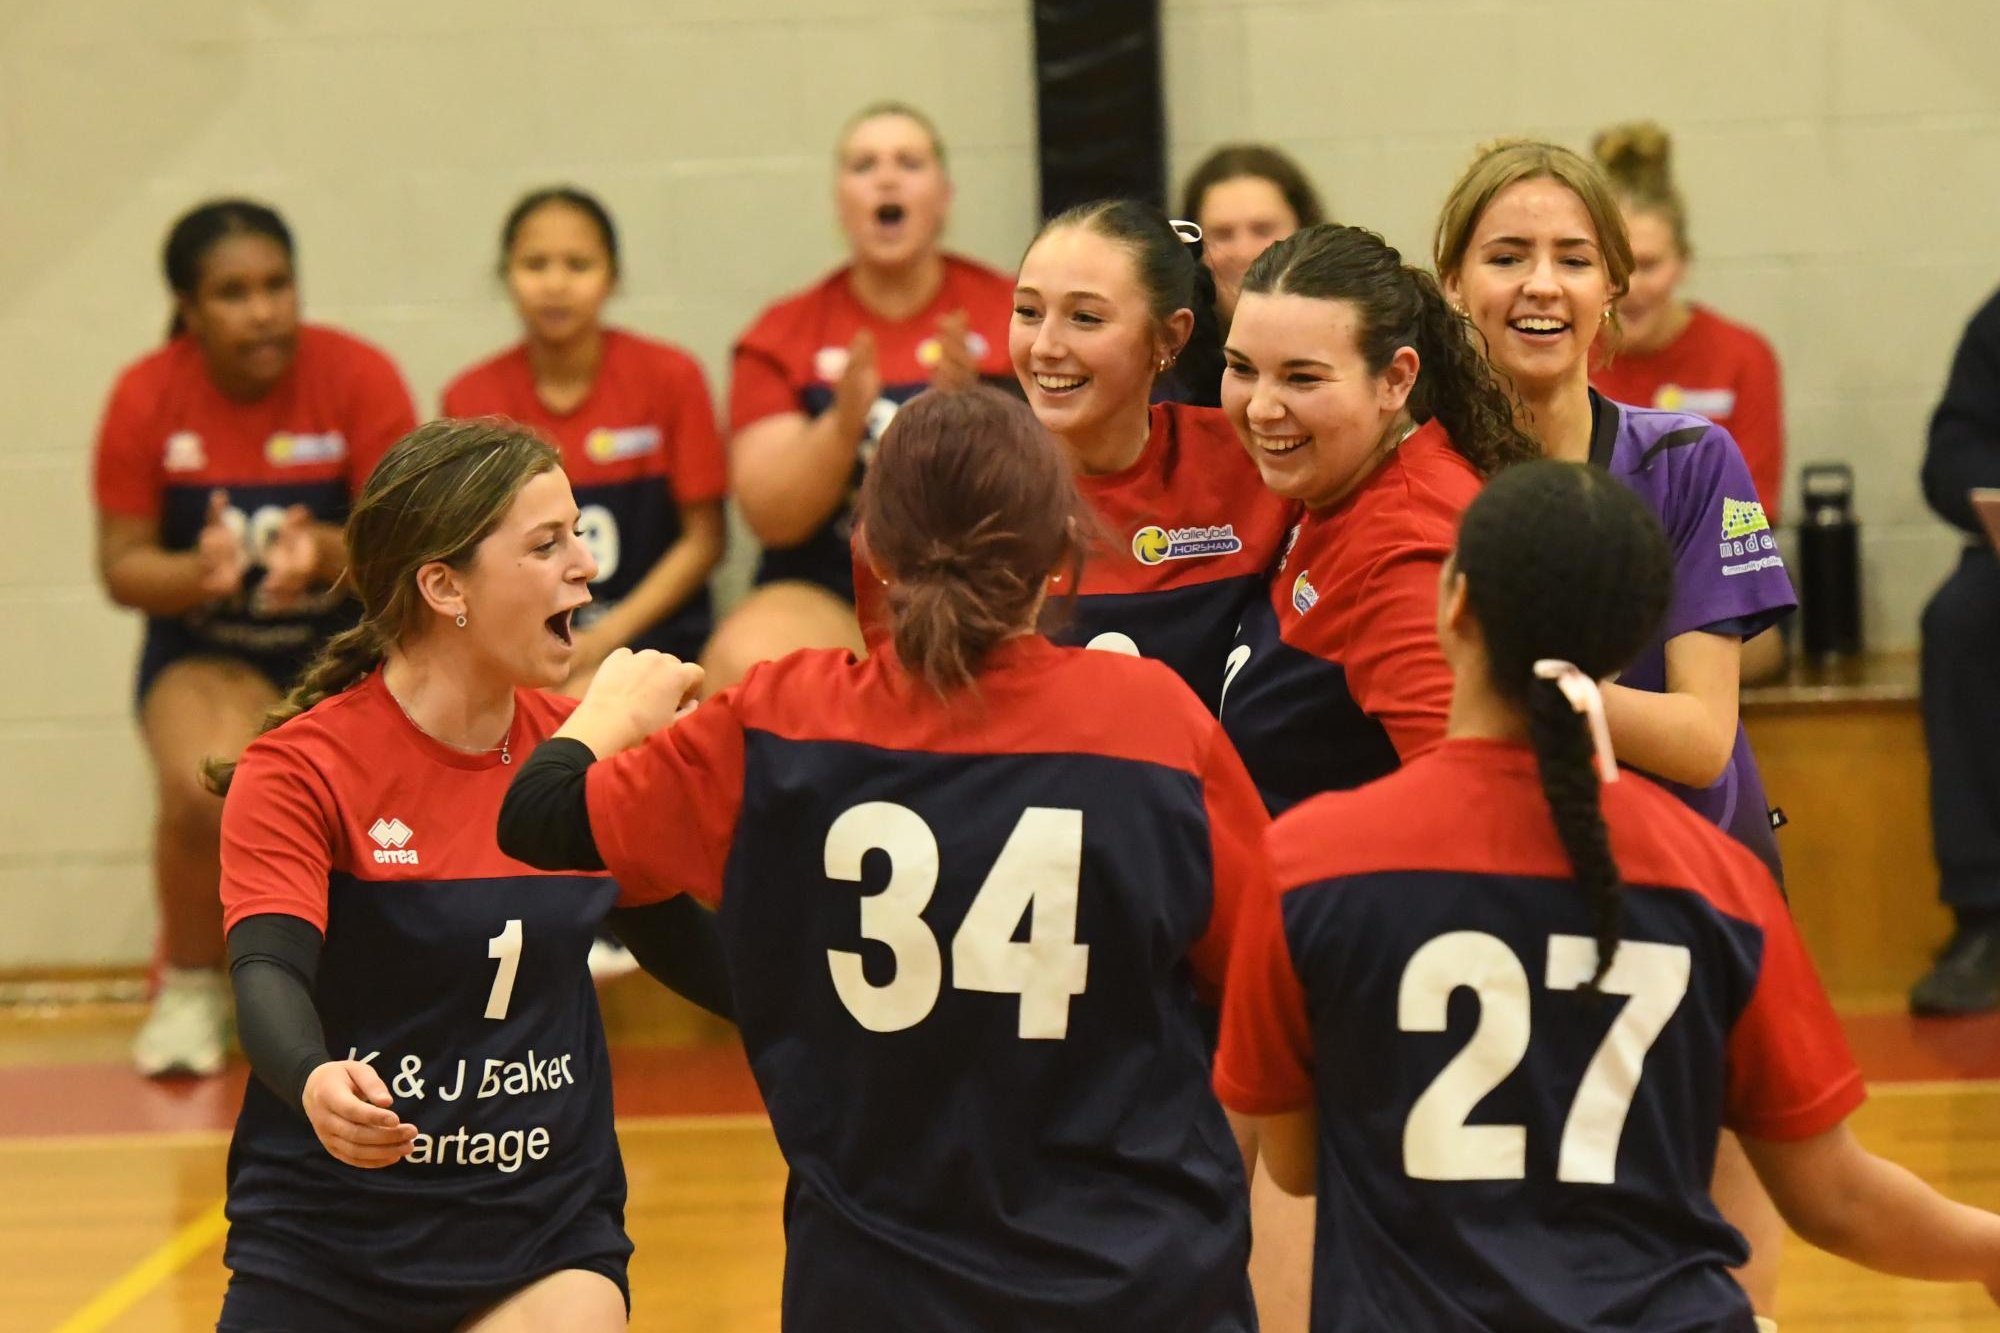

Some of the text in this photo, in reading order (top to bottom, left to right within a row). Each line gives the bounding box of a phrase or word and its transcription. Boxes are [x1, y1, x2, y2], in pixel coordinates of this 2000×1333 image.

[1169, 526, 1231, 541] Volleyball
[1175, 542, 1233, 554] HORSHAM
[824, 800, 1089, 1041] 34
[484, 919, 522, 1020] 1
[392, 1054, 425, 1100] &
[438, 1059, 466, 1101] J
[1398, 930, 1692, 1185] 27
[404, 1125, 550, 1173] artage
